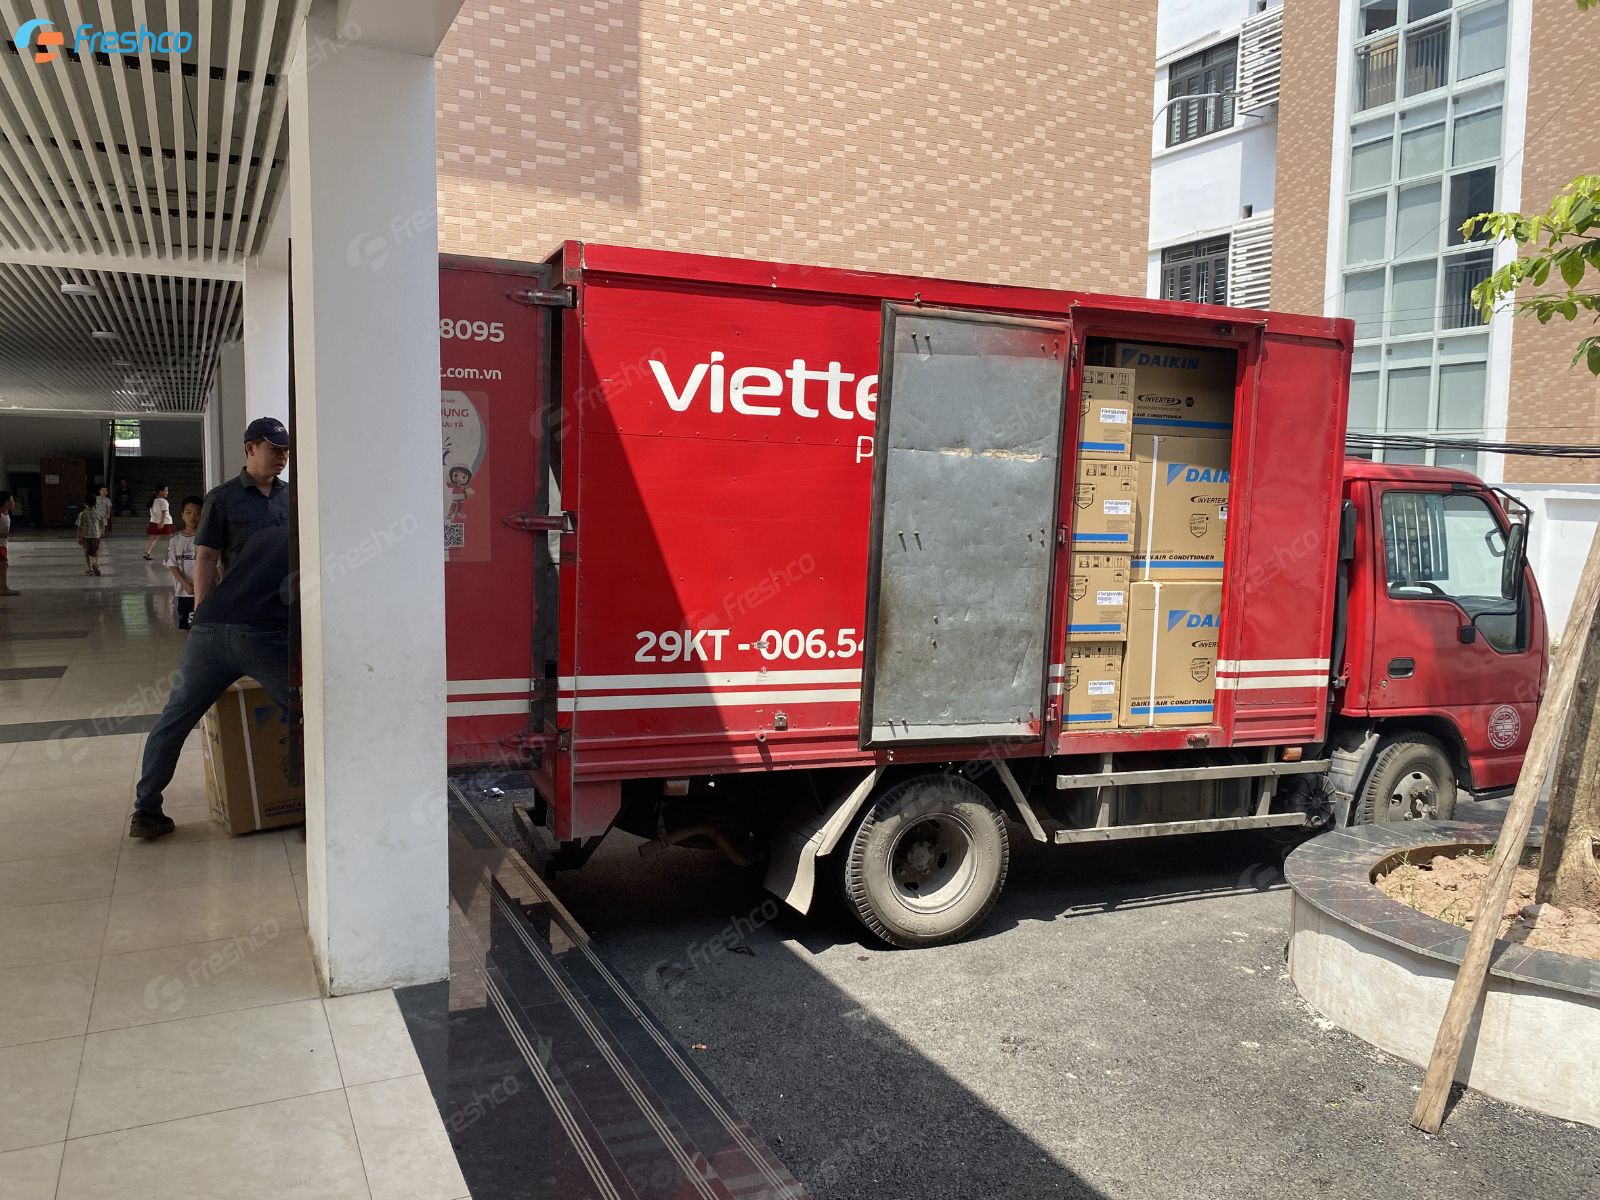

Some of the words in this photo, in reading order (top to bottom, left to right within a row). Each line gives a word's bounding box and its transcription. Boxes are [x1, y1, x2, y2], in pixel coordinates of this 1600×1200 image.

[440, 318, 505, 343] 8095
[1137, 352, 1199, 370] DAIKIN
[1144, 395, 1177, 405] INVERTER
[441, 408, 469, 419] ỤNG
[634, 629, 730, 663] 29KT
[759, 628, 864, 661] 006.5
